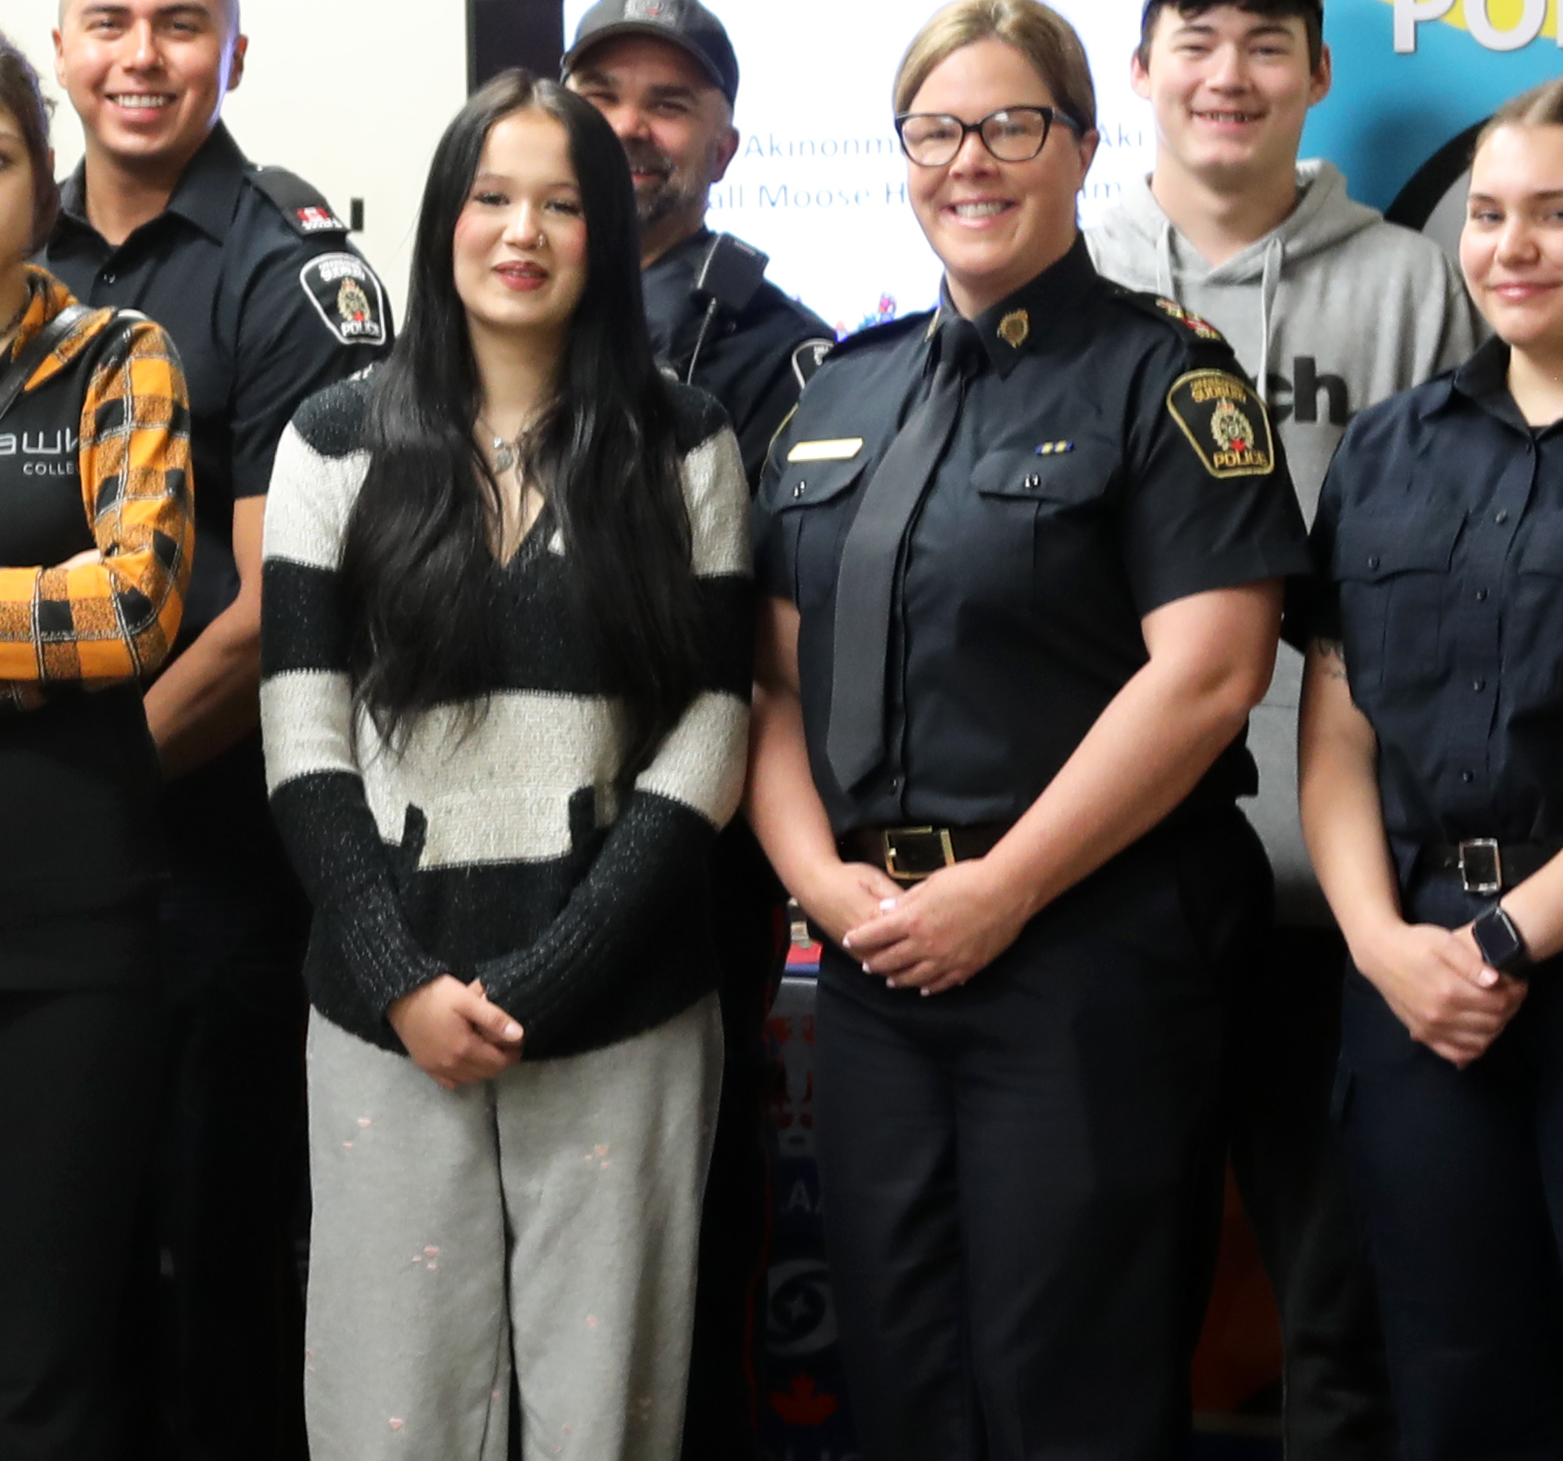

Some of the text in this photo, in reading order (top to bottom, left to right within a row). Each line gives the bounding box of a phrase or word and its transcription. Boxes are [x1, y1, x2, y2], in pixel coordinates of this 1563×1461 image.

[707, 183, 744, 211] all
[758, 183, 871, 210] Moose
[1252, 355, 1349, 425] ch
[22, 460, 75, 476] COLLE
[1213, 449, 1268, 469] POLICE
